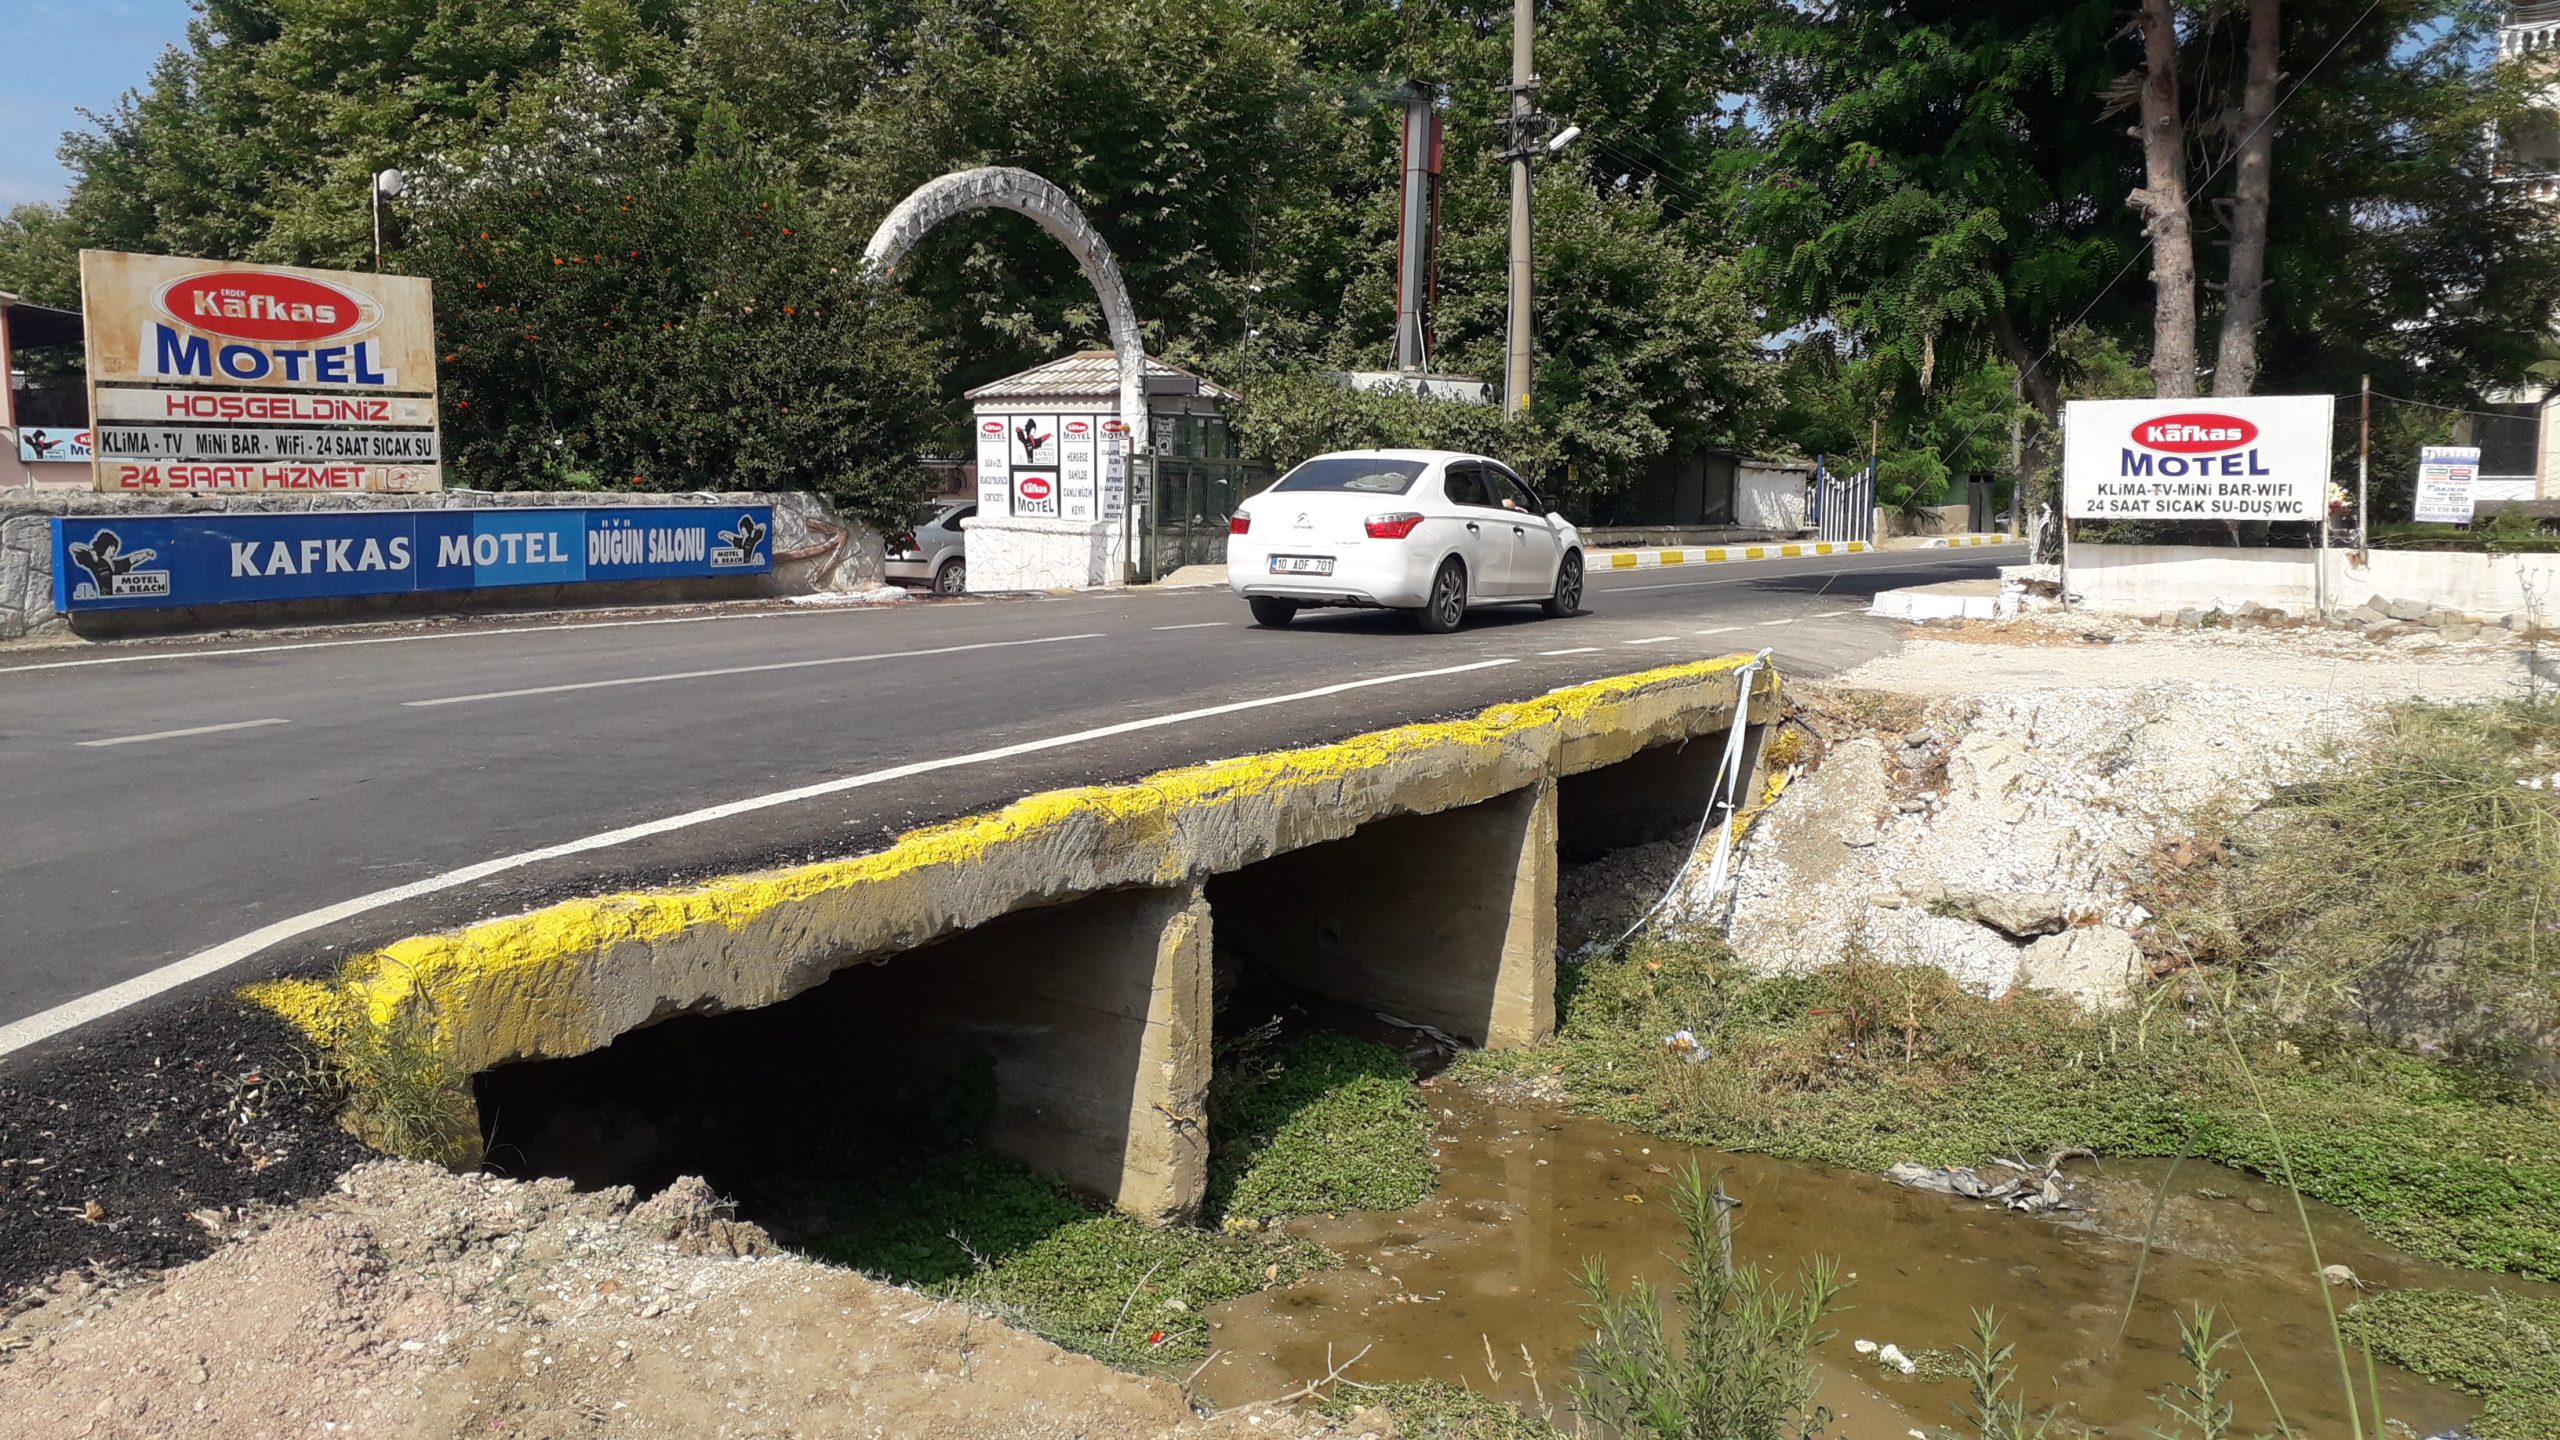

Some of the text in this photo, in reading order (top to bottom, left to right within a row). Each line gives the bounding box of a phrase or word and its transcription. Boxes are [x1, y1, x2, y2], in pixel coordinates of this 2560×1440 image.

[221, 288, 247, 298] ERDEK
[193, 289, 336, 324] Kafkas
[155, 322, 385, 386] MOTEL
[980, 432, 1006, 440] MOTEL
[1063, 431, 1091, 440] MOTEL
[2147, 424, 2243, 443] Kafkas
[163, 432, 183, 454] TV
[232, 434, 261, 455] BAR
[276, 434, 305, 456] WiFi
[316, 435, 332, 456] 24
[336, 436, 369, 456] SAAT
[373, 437, 412, 457] SICAK
[415, 438, 431, 457] SU
[2120, 447, 2270, 477] MOTEL
[120, 466, 161, 488] 24
[167, 466, 254, 488] SAAT
[2218, 483, 2293, 497] BAR-WIFI
[1017, 495, 1054, 513] MOTEL
[2086, 499, 2105, 512] 24
[2110, 499, 2151, 513] SAAT
[2155, 499, 2206, 513] SICAK
[436, 531, 569, 568] MOTEL
[588, 518, 706, 566] DÜĞÜN SALONU
[230, 535, 411, 578] KAFKAS
[1278, 558, 1332, 571] 10 ADF 701
[121, 576, 159, 585] MOTEL
[129, 584, 165, 593] BEACH
